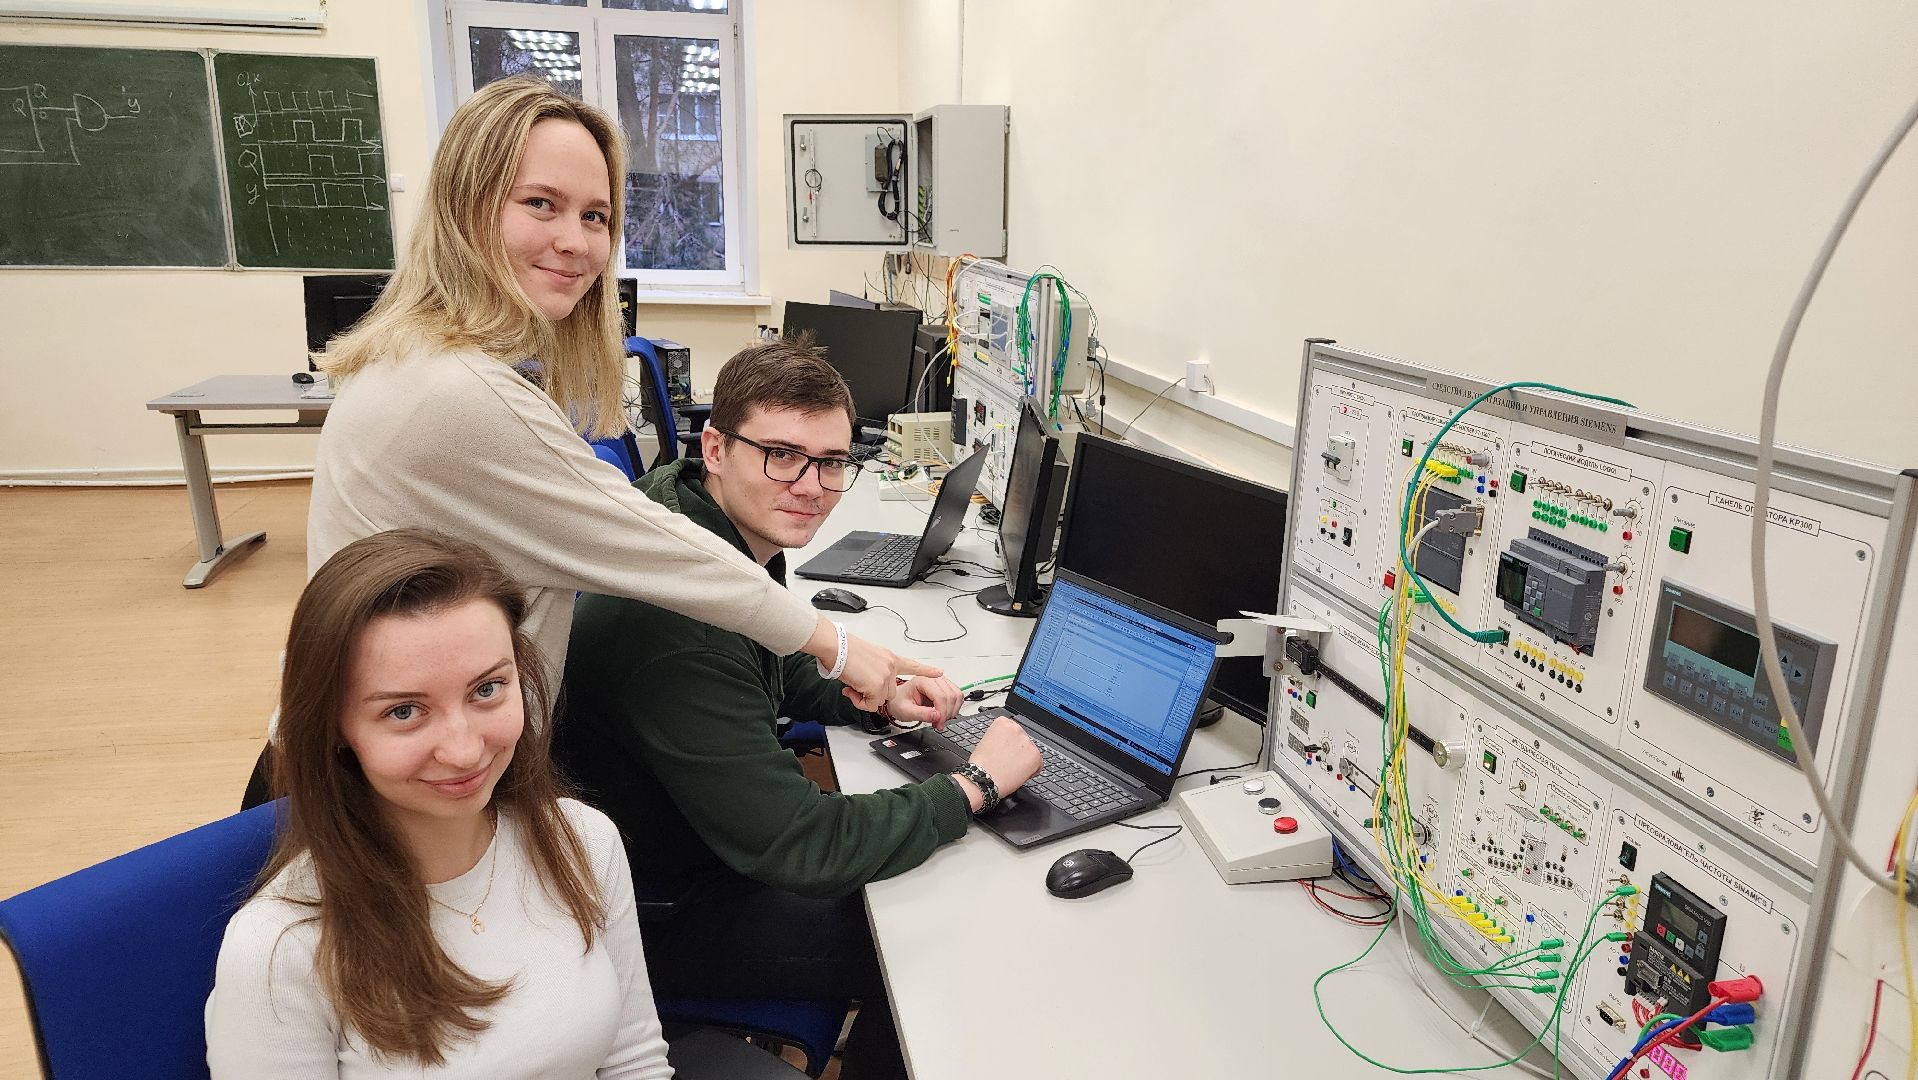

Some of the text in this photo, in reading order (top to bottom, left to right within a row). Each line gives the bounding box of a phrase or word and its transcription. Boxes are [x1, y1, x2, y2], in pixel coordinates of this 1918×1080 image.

[1529, 405, 1579, 425] УПРАВЛЕНИЯ
[1580, 417, 1617, 434] SIEMENS
[1714, 495, 1742, 510] ПАНЕЛЬ
[1744, 504, 1788, 524] ОПТОРА
[1637, 818, 1768, 908] ПРЕОБРАЗОВАТЕЛЬ ЧАСТОТЫ SINAMICS
